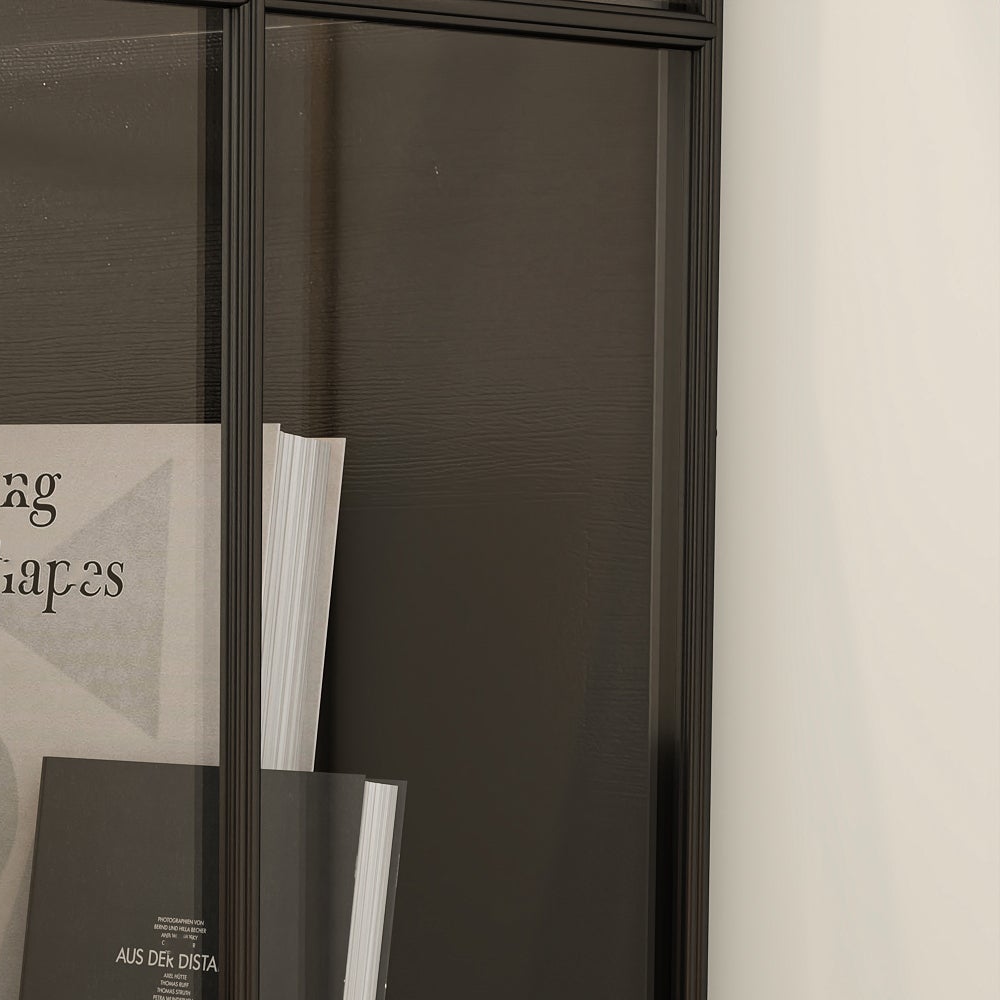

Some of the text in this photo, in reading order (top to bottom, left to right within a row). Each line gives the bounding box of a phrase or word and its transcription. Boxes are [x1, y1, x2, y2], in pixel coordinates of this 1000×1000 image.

[115, 946, 144, 965] AUS
[178, 953, 219, 973] DISTA
[157, 987, 175, 995] THOMAS
